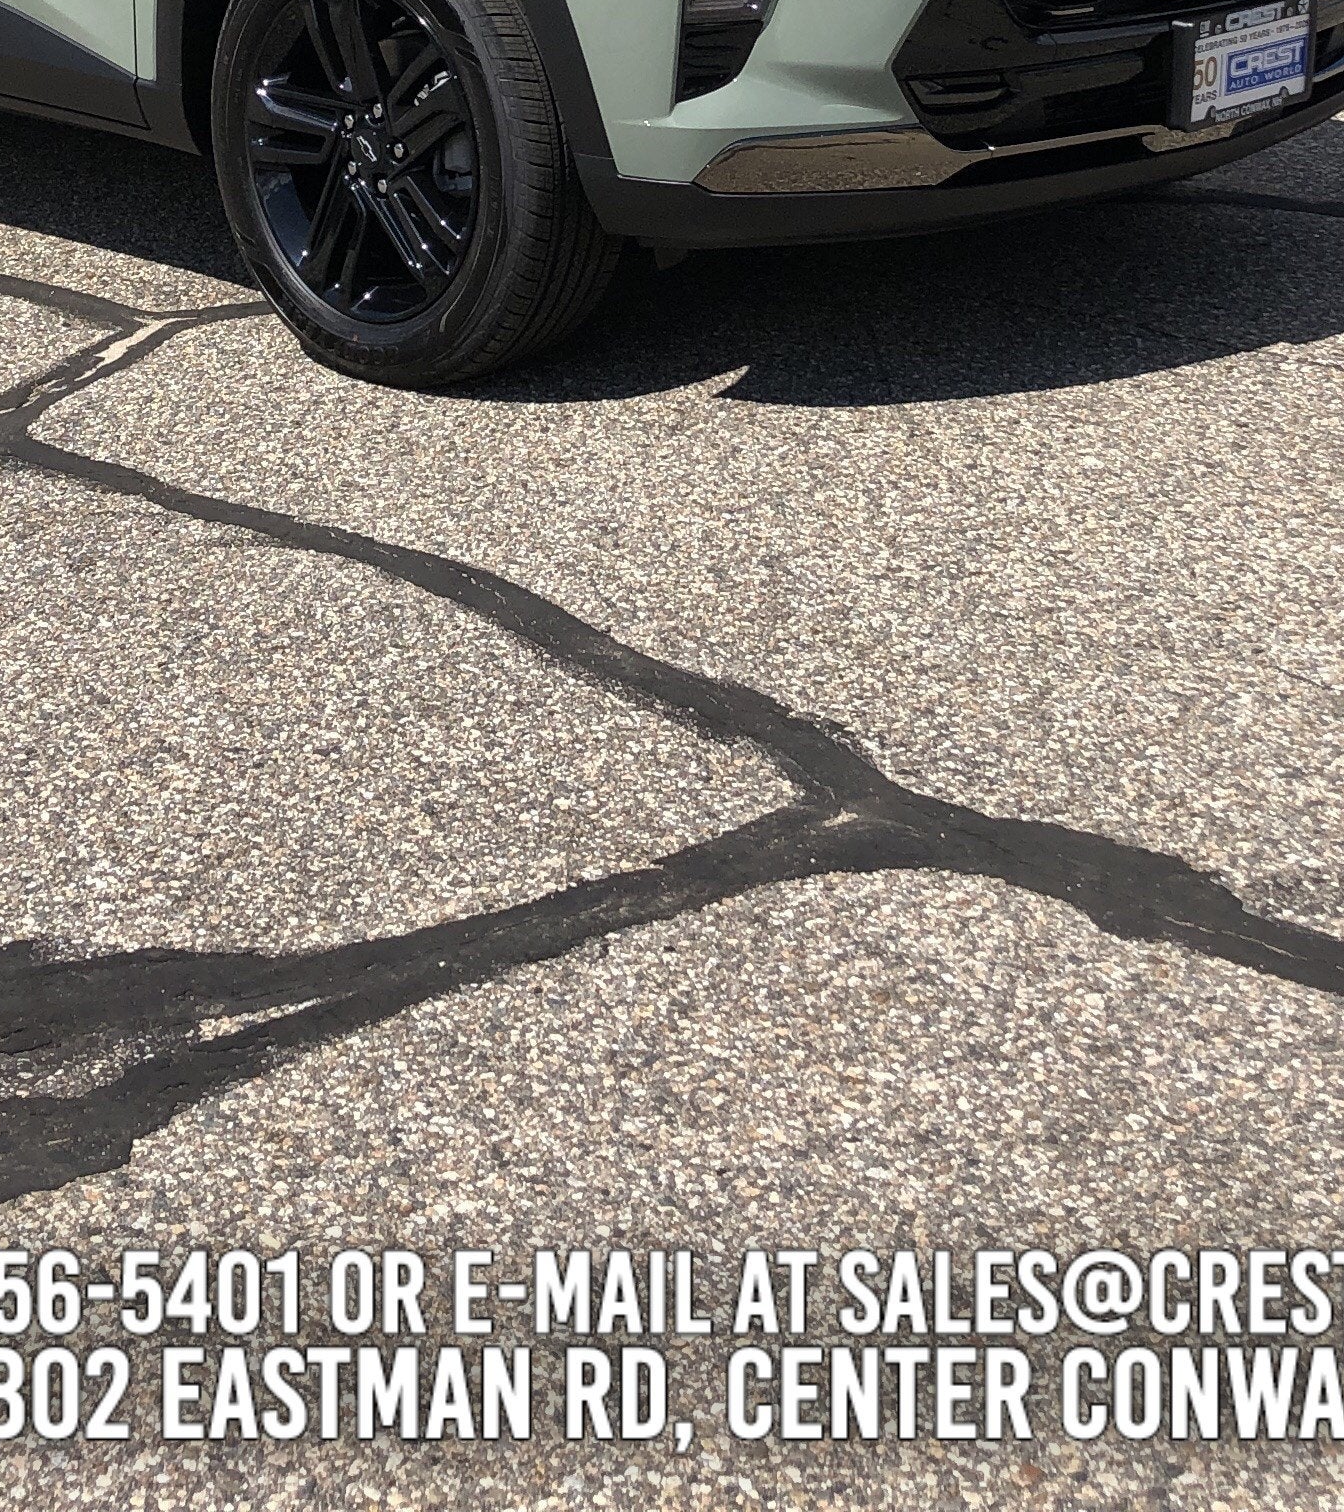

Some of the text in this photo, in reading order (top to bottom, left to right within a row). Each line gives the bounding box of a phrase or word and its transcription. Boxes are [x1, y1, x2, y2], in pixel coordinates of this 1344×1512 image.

[1224, 0, 1286, 32] CREST
[1193, 56, 1218, 90] 50
[1230, 40, 1304, 79] CREST
[1229, 63, 1303, 91] AUTO WORLD
[1193, 90, 1218, 105] EARS
